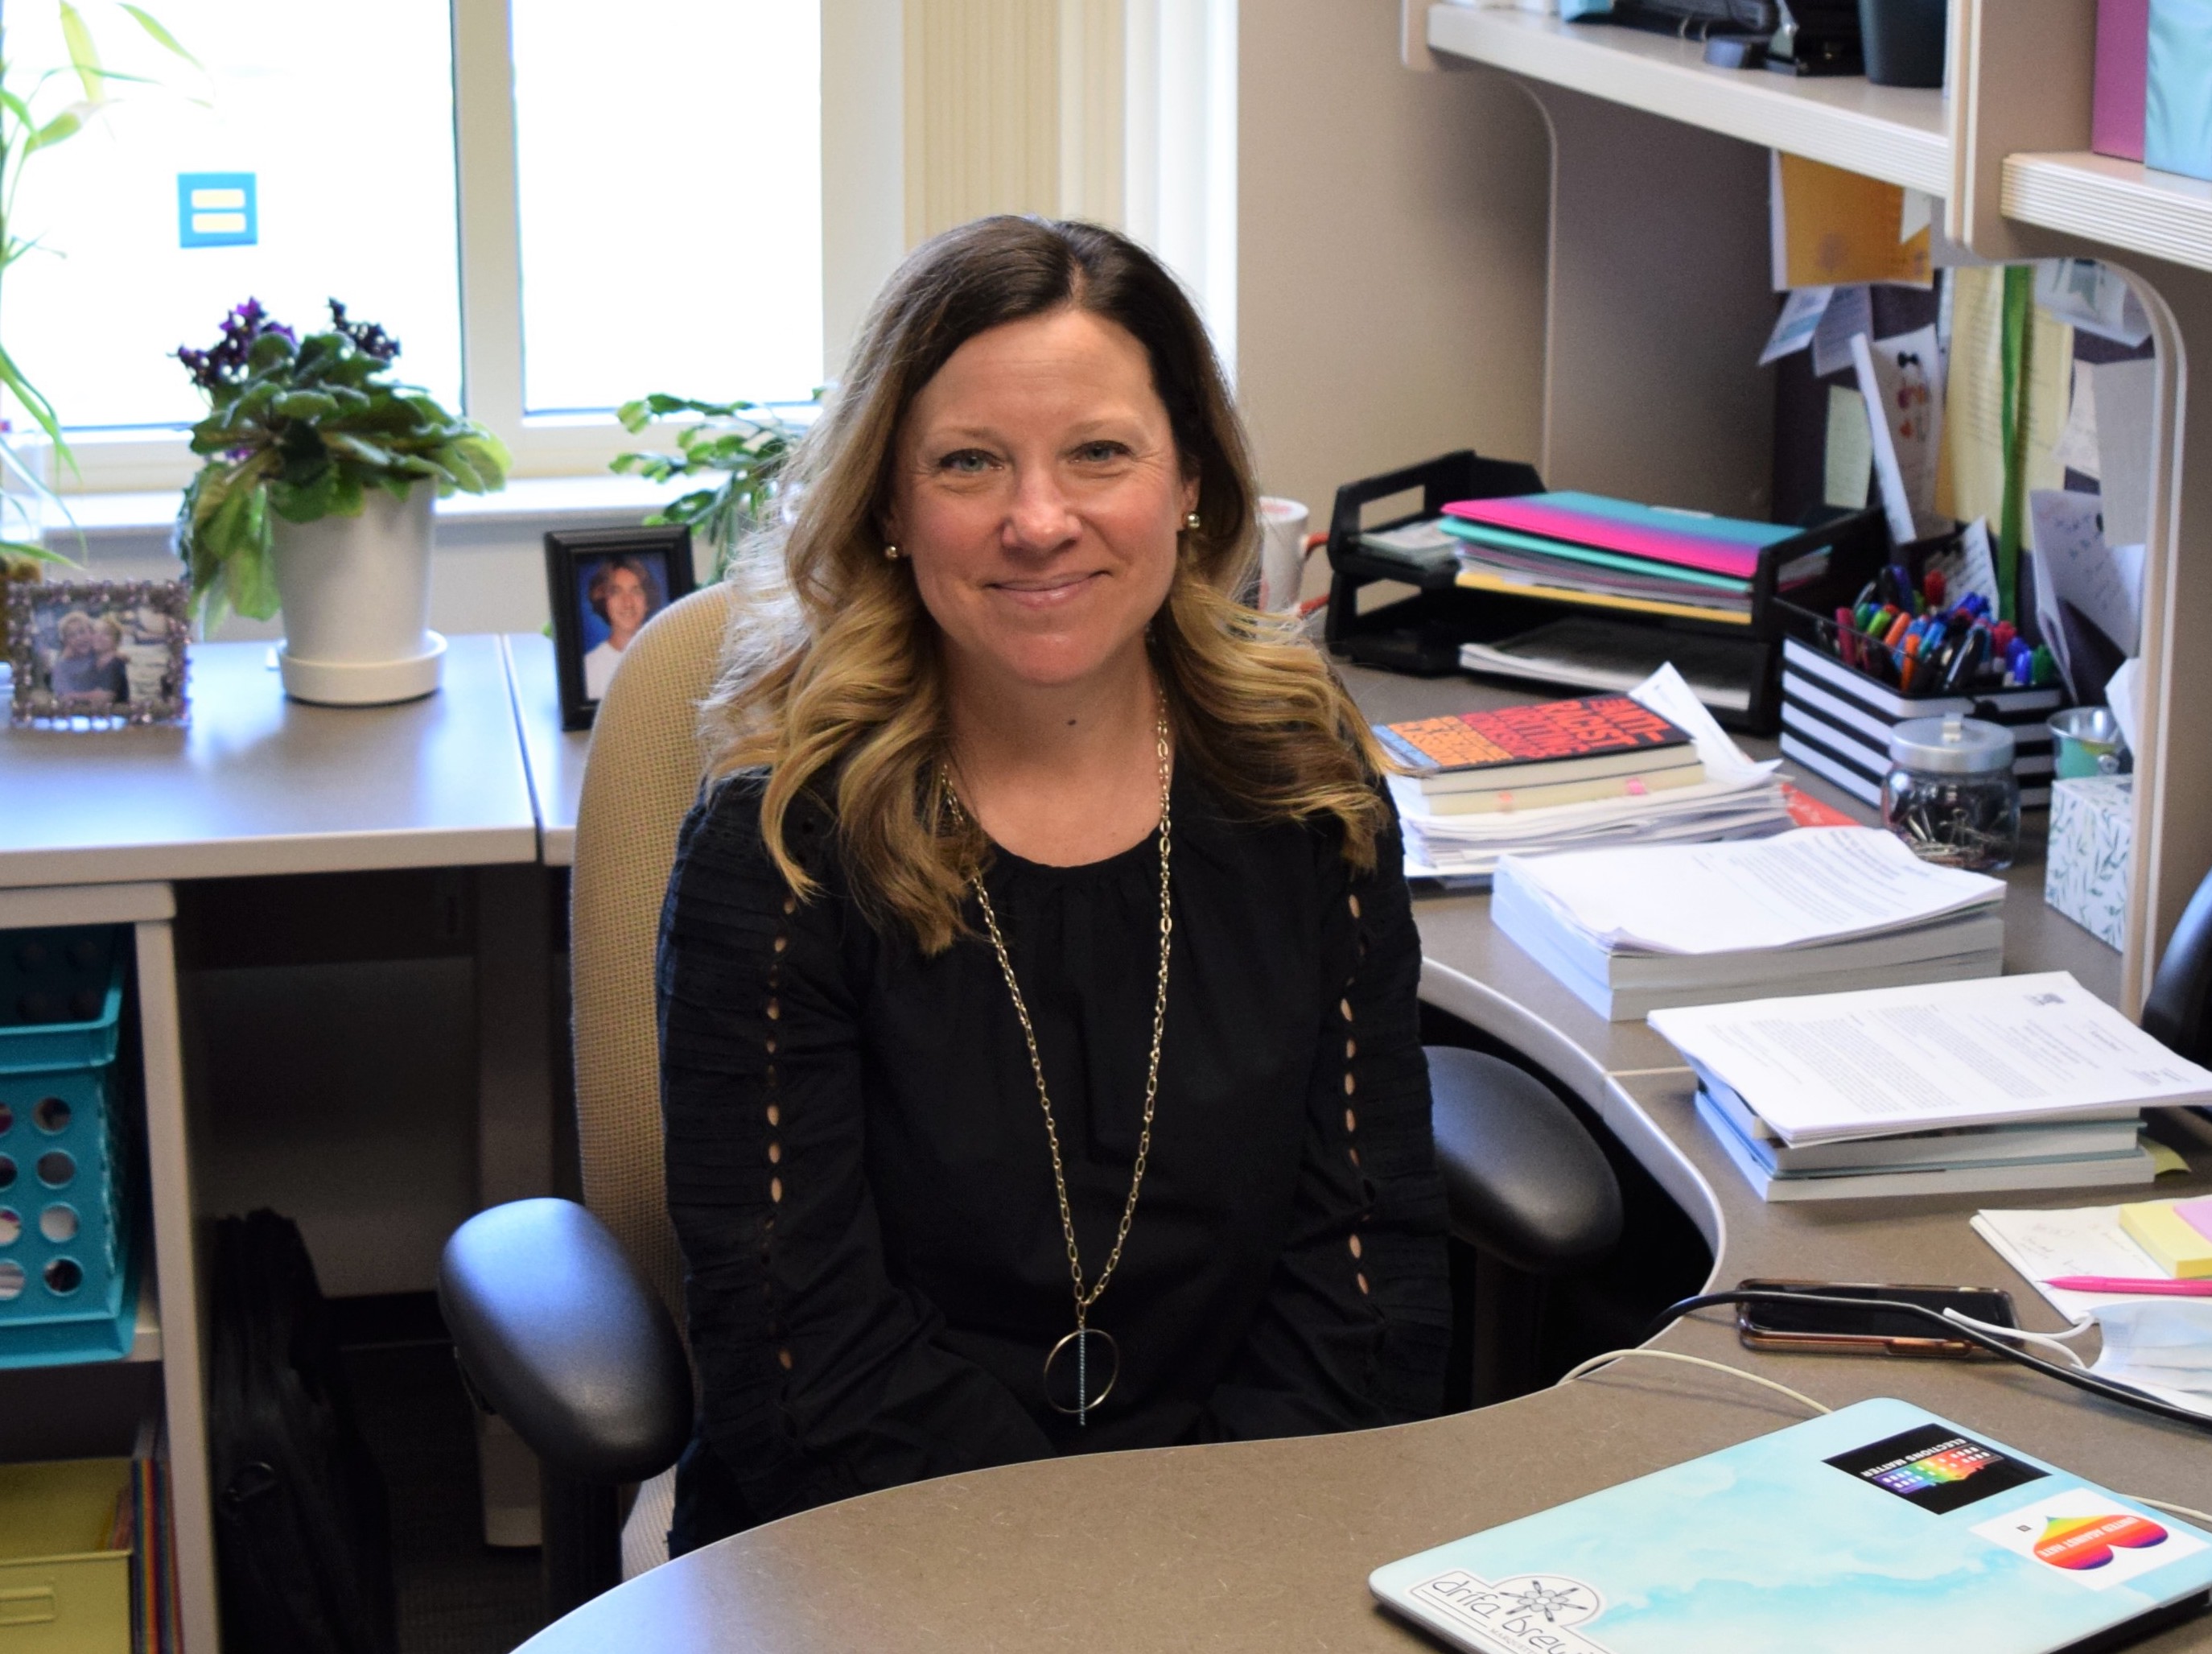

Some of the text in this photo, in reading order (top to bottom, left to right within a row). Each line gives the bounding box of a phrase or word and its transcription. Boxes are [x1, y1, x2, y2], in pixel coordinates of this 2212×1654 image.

[1860, 1437, 1967, 1478] ELECTIONS MATTER
[2038, 1516, 2138, 1557] UNITED AGAINST HATE
